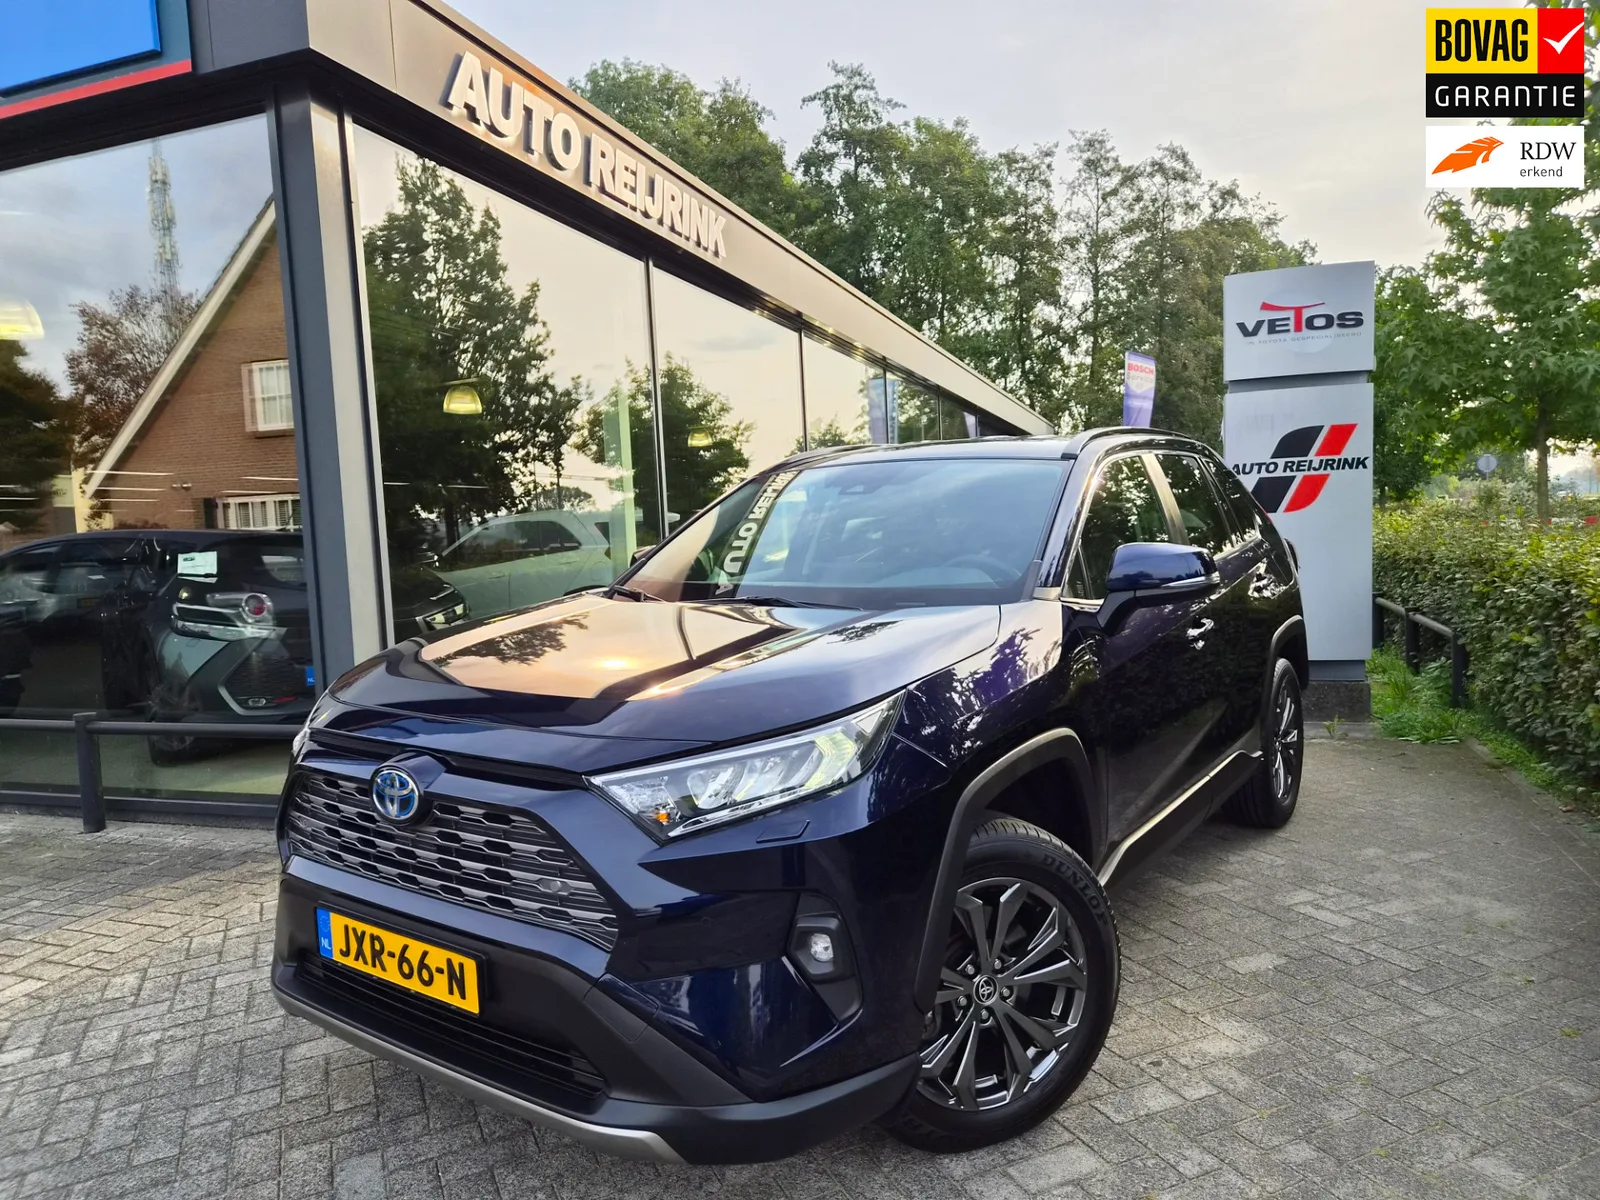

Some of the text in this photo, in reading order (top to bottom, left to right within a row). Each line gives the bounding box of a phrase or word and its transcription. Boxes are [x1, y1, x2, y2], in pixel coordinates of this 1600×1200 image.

[447, 50, 727, 258] AUTO REIJRINK
[1236, 301, 1364, 338] VETOS
[1127, 362, 1155, 375] BOSCH
[1231, 456, 1370, 476] AUTO REIJRINK
[1040, 852, 1109, 925] DUNLOP
[321, 936, 332, 950] NL
[339, 923, 467, 1001] JXR-66-N
